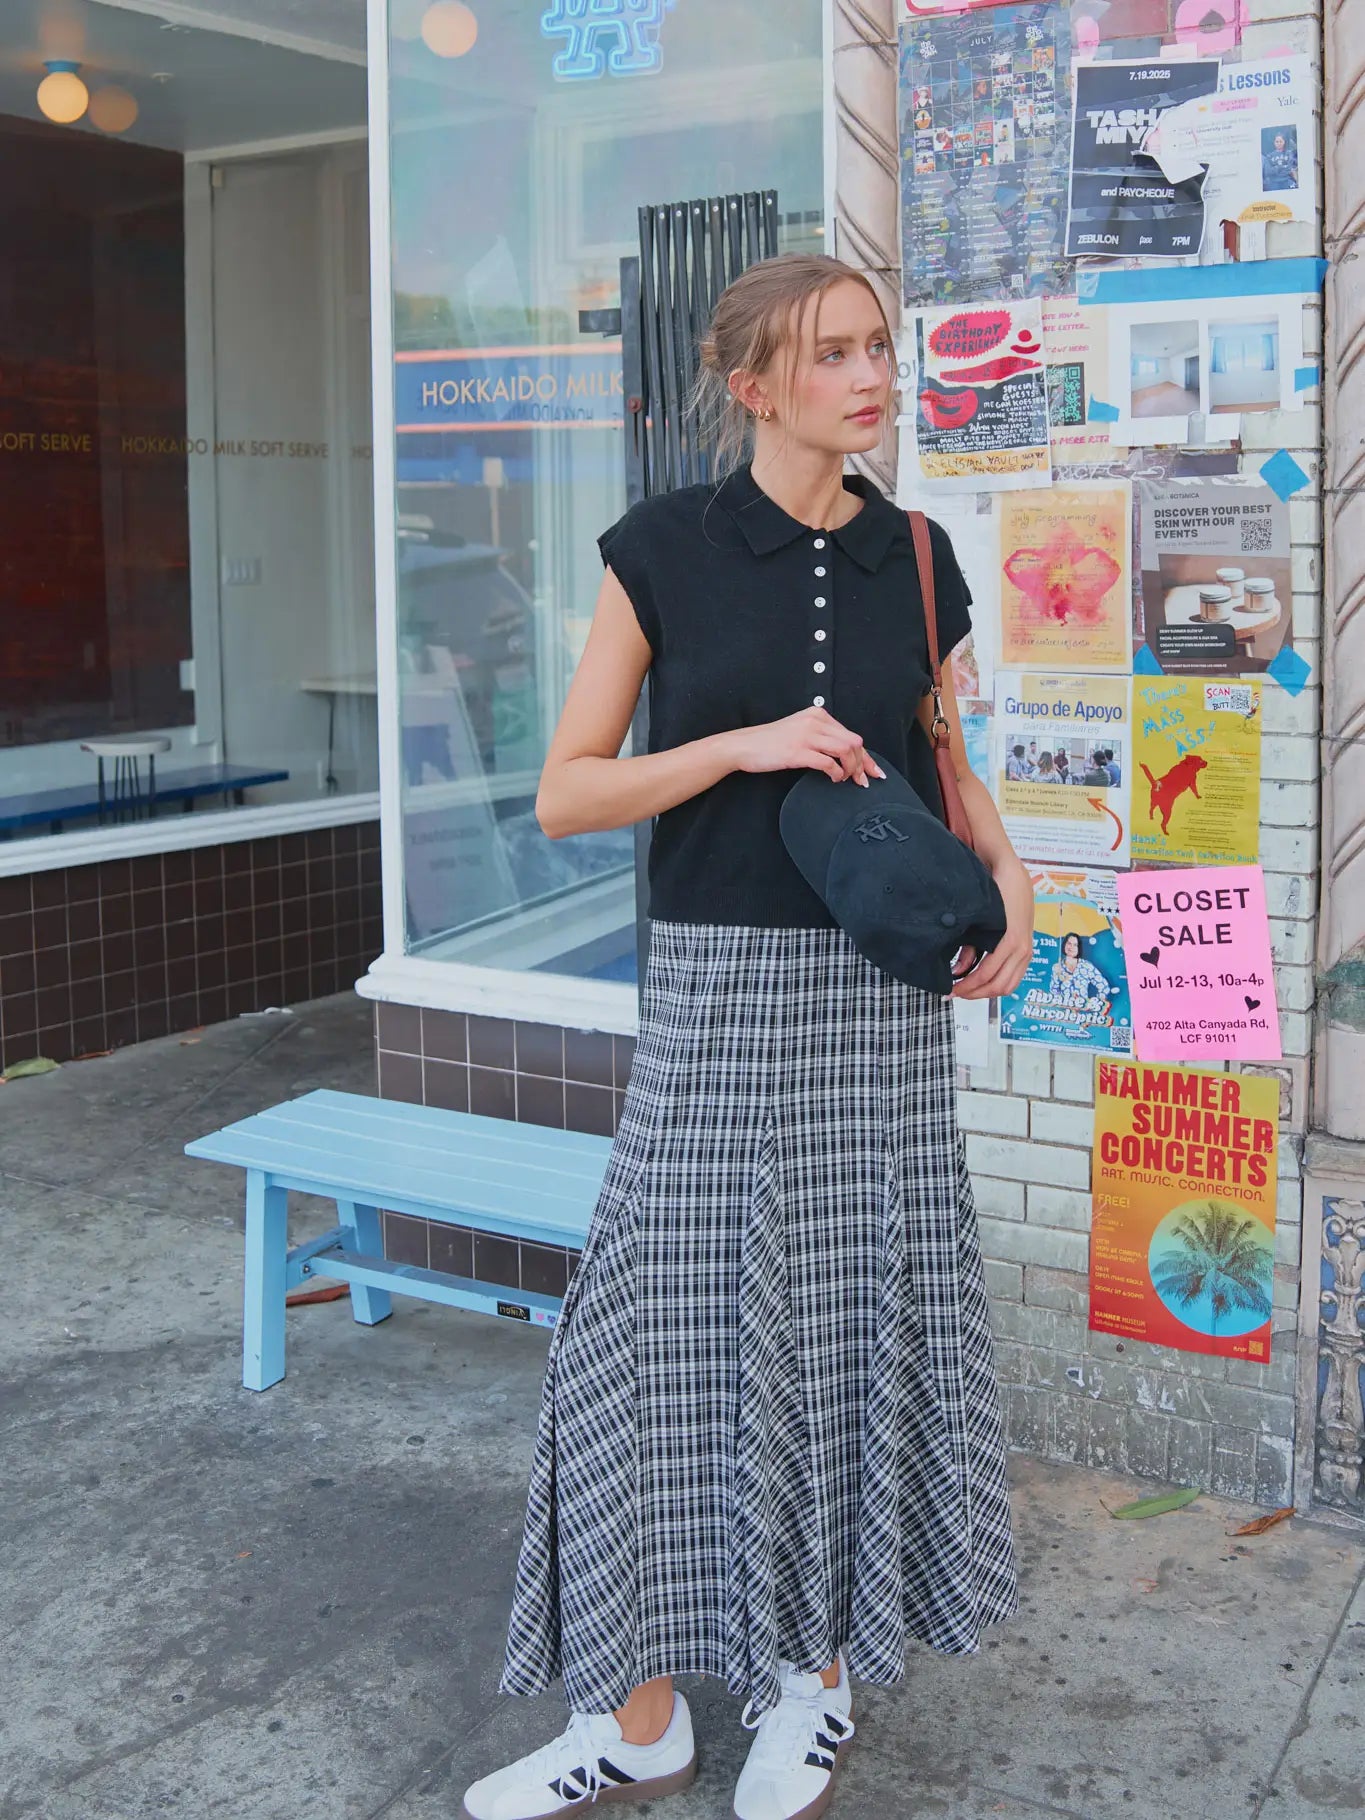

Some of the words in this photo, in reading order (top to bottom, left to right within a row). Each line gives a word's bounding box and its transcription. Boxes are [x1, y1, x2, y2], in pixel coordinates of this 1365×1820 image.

[970, 35, 992, 47] JULY
[1129, 70, 1171, 81] 7.19.2025
[1228, 68, 1291, 91] Lessons
[1101, 187, 1118, 197] and
[1119, 187, 1175, 199] PAYCHEQUE
[1077, 234, 1119, 245] ZEBULON
[1172, 236, 1191, 247] 7PM
[940, 323, 1002, 340] BIRTHDAY
[949, 319, 968, 329] THE
[421, 373, 558, 407] HOKKAIDO
[566, 369, 624, 399] MILK
[1003, 382, 1038, 394] SPECIAL
[984, 400, 1012, 409] MEGAN
[0, 433, 35, 451] OFT
[41, 433, 92, 452] SERVE
[121, 435, 208, 456] HOKKAIDO
[213, 440, 246, 457] MILK
[250, 441, 284, 457] SOFT
[287, 442, 329, 459] SERVE
[1154, 507, 1209, 518] DISCOVER
[1211, 505, 1241, 516] YOUR
[1242, 504, 1272, 514] BEST
[1154, 519, 1180, 529] SKIN
[1181, 518, 1210, 528] WITH
[1211, 517, 1235, 526] OUR
[1154, 529, 1199, 539] EVENTS
[1206, 687, 1231, 699] SCAN
[1005, 697, 1049, 719] Grupo
[1052, 700, 1071, 717] de
[1074, 700, 1123, 723] Apoyo
[1212, 702, 1230, 711] BUTT
[1023, 722, 1046, 734] para
[1048, 723, 1101, 736] Familiares
[1143, 708, 1185, 739] MASS
[1175, 720, 1216, 757] ASS!
[1134, 888, 1250, 914] CLOSET
[1040, 938, 1057, 947] 13th
[1158, 923, 1233, 947] SALE
[1139, 976, 1162, 989] Jul
[1167, 974, 1213, 989] 12-13,
[1217, 972, 1265, 987] 10a-4p
[1024, 988, 1086, 1008] Awake
[1022, 1004, 1106, 1025] Narcoleptic
[1039, 1023, 1062, 1033] WITH
[1145, 1021, 1171, 1031] 4702
[1174, 1020, 1196, 1030] Alta
[1198, 1019, 1247, 1031] Canyada
[1250, 1018, 1269, 1030] Rd,
[1180, 1034, 1202, 1044] LCF
[1205, 1033, 1237, 1043] 91011
[1099, 1063, 1241, 1114] HAMMER
[1132, 1102, 1274, 1154] SUMMER
[1100, 1131, 1268, 1187] CONCERTS
[1101, 1166, 1126, 1181] ART.
[1130, 1170, 1175, 1188] MUSIC.
[1178, 1178, 1265, 1203] CONNECTION.
[1098, 1193, 1130, 1209] FREE!
[1095, 1310, 1120, 1322] HAMMER
[1121, 1316, 1146, 1328] MUSEUM
